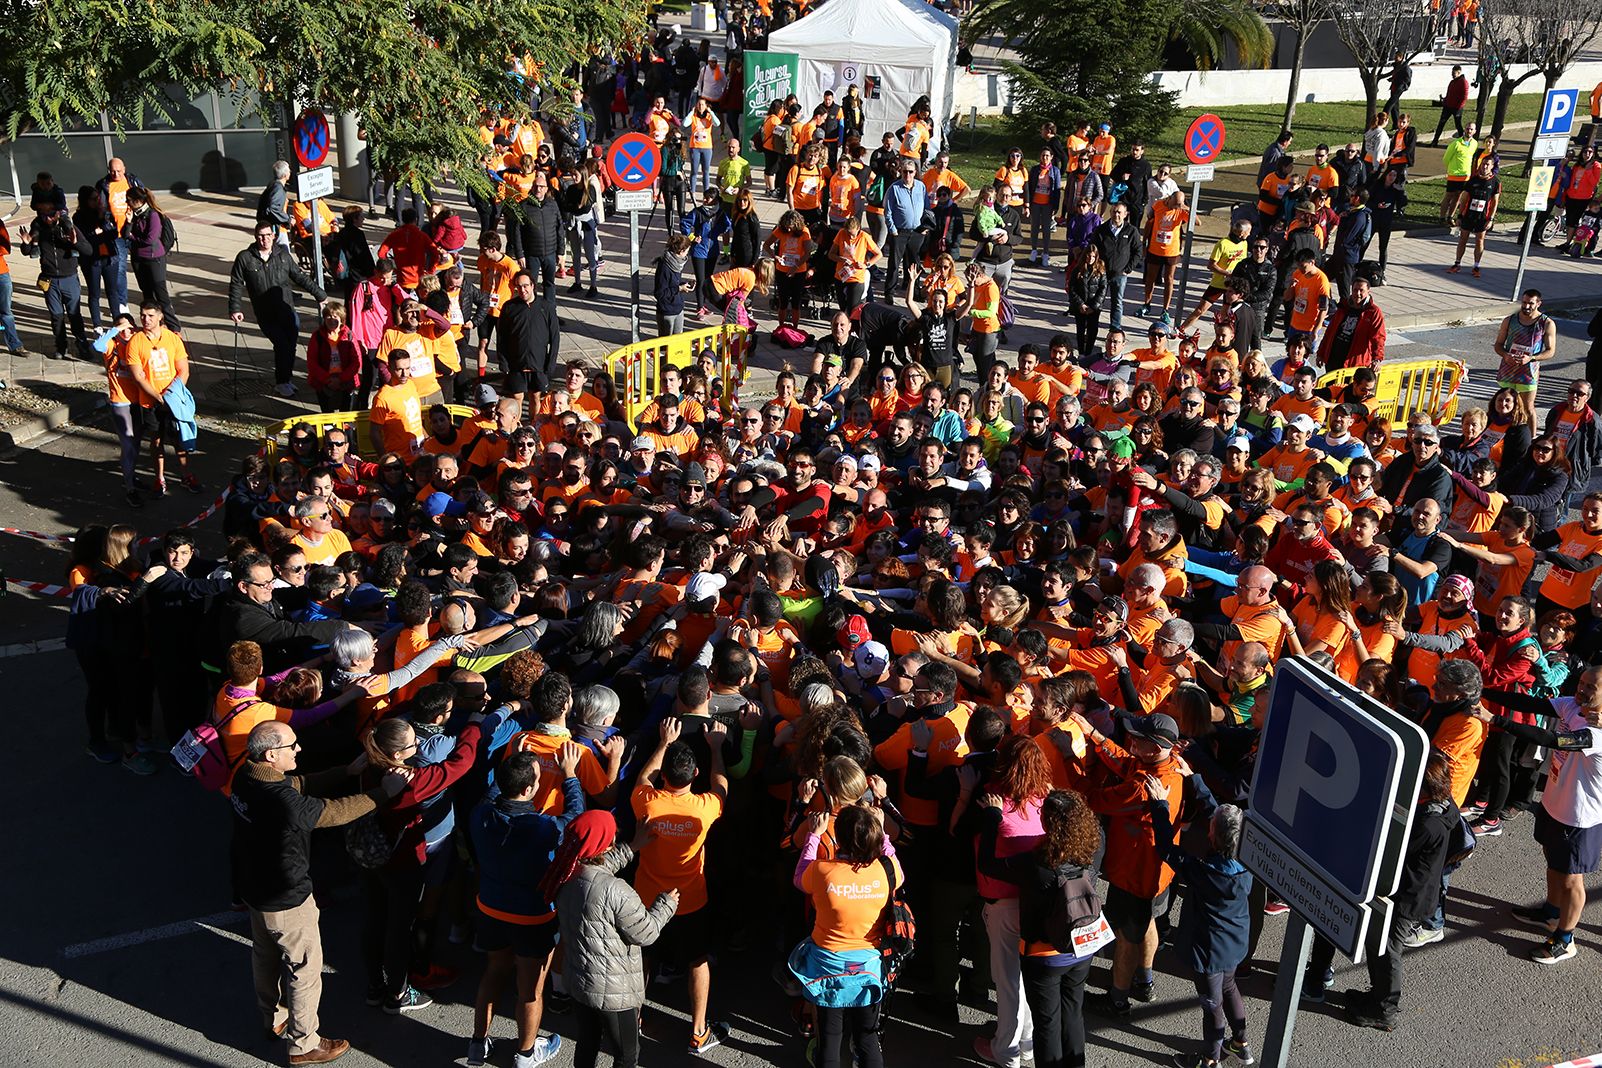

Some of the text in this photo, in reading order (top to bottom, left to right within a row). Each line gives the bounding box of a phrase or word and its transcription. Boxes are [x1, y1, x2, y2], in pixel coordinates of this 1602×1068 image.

[764, 64, 791, 80] cursa
[1546, 94, 1571, 130] P
[713, 714, 735, 725] SHER
[1272, 690, 1360, 828] P
[826, 882, 873, 896] Applus
[1246, 830, 1354, 926] Exclusiu clients Hotel
[1257, 858, 1274, 878] Vila
[1276, 874, 1341, 935] Universitària
